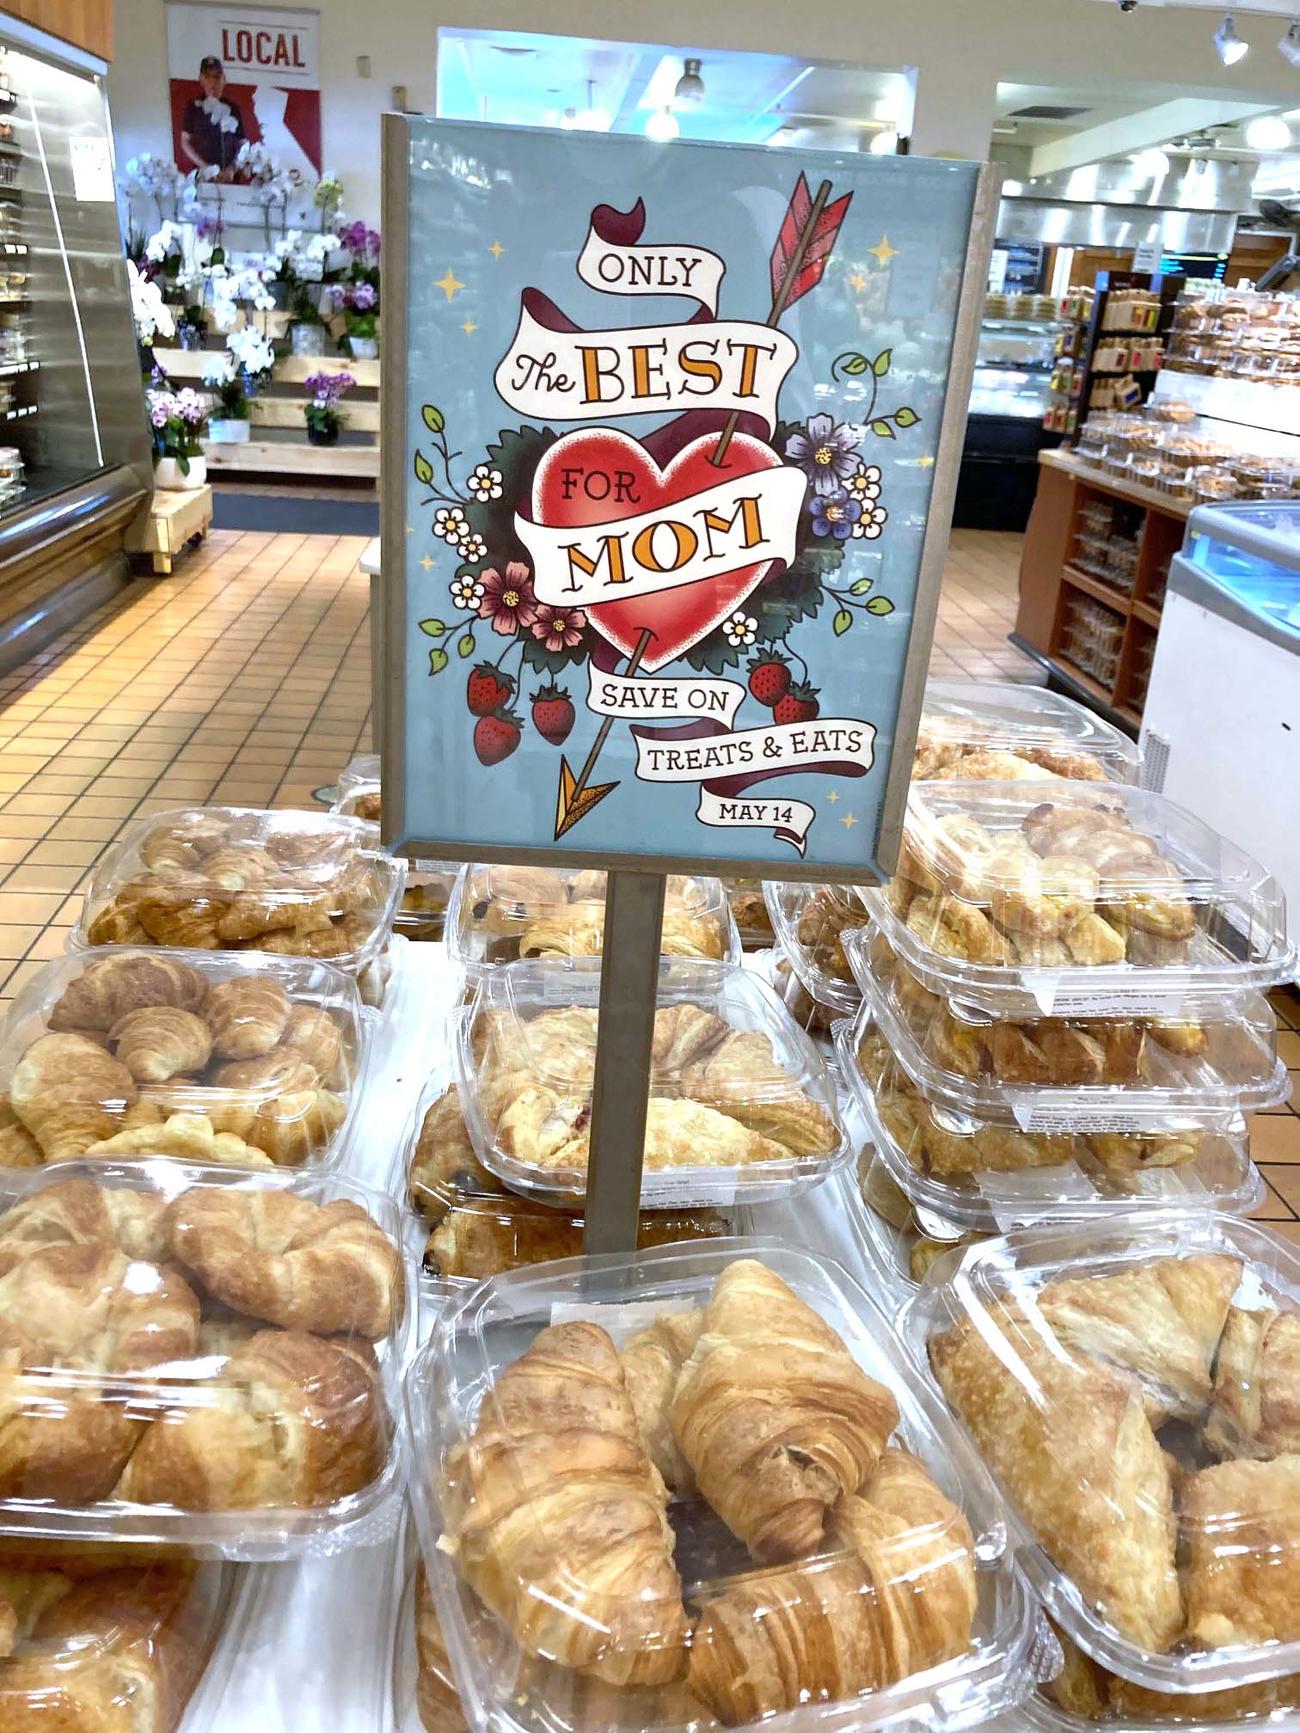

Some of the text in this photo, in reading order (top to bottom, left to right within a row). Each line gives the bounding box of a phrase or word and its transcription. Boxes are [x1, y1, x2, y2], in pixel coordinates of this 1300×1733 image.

[222, 28, 306, 68] LOCAL
[598, 253, 702, 287] ONLY
[511, 338, 777, 405] The BEST
[561, 467, 641, 503] FOR
[558, 494, 770, 593] MOM
[601, 684, 729, 712] SAVE ON
[647, 729, 863, 771] TREATS & EATS
[719, 804, 793, 823] MAY 14
